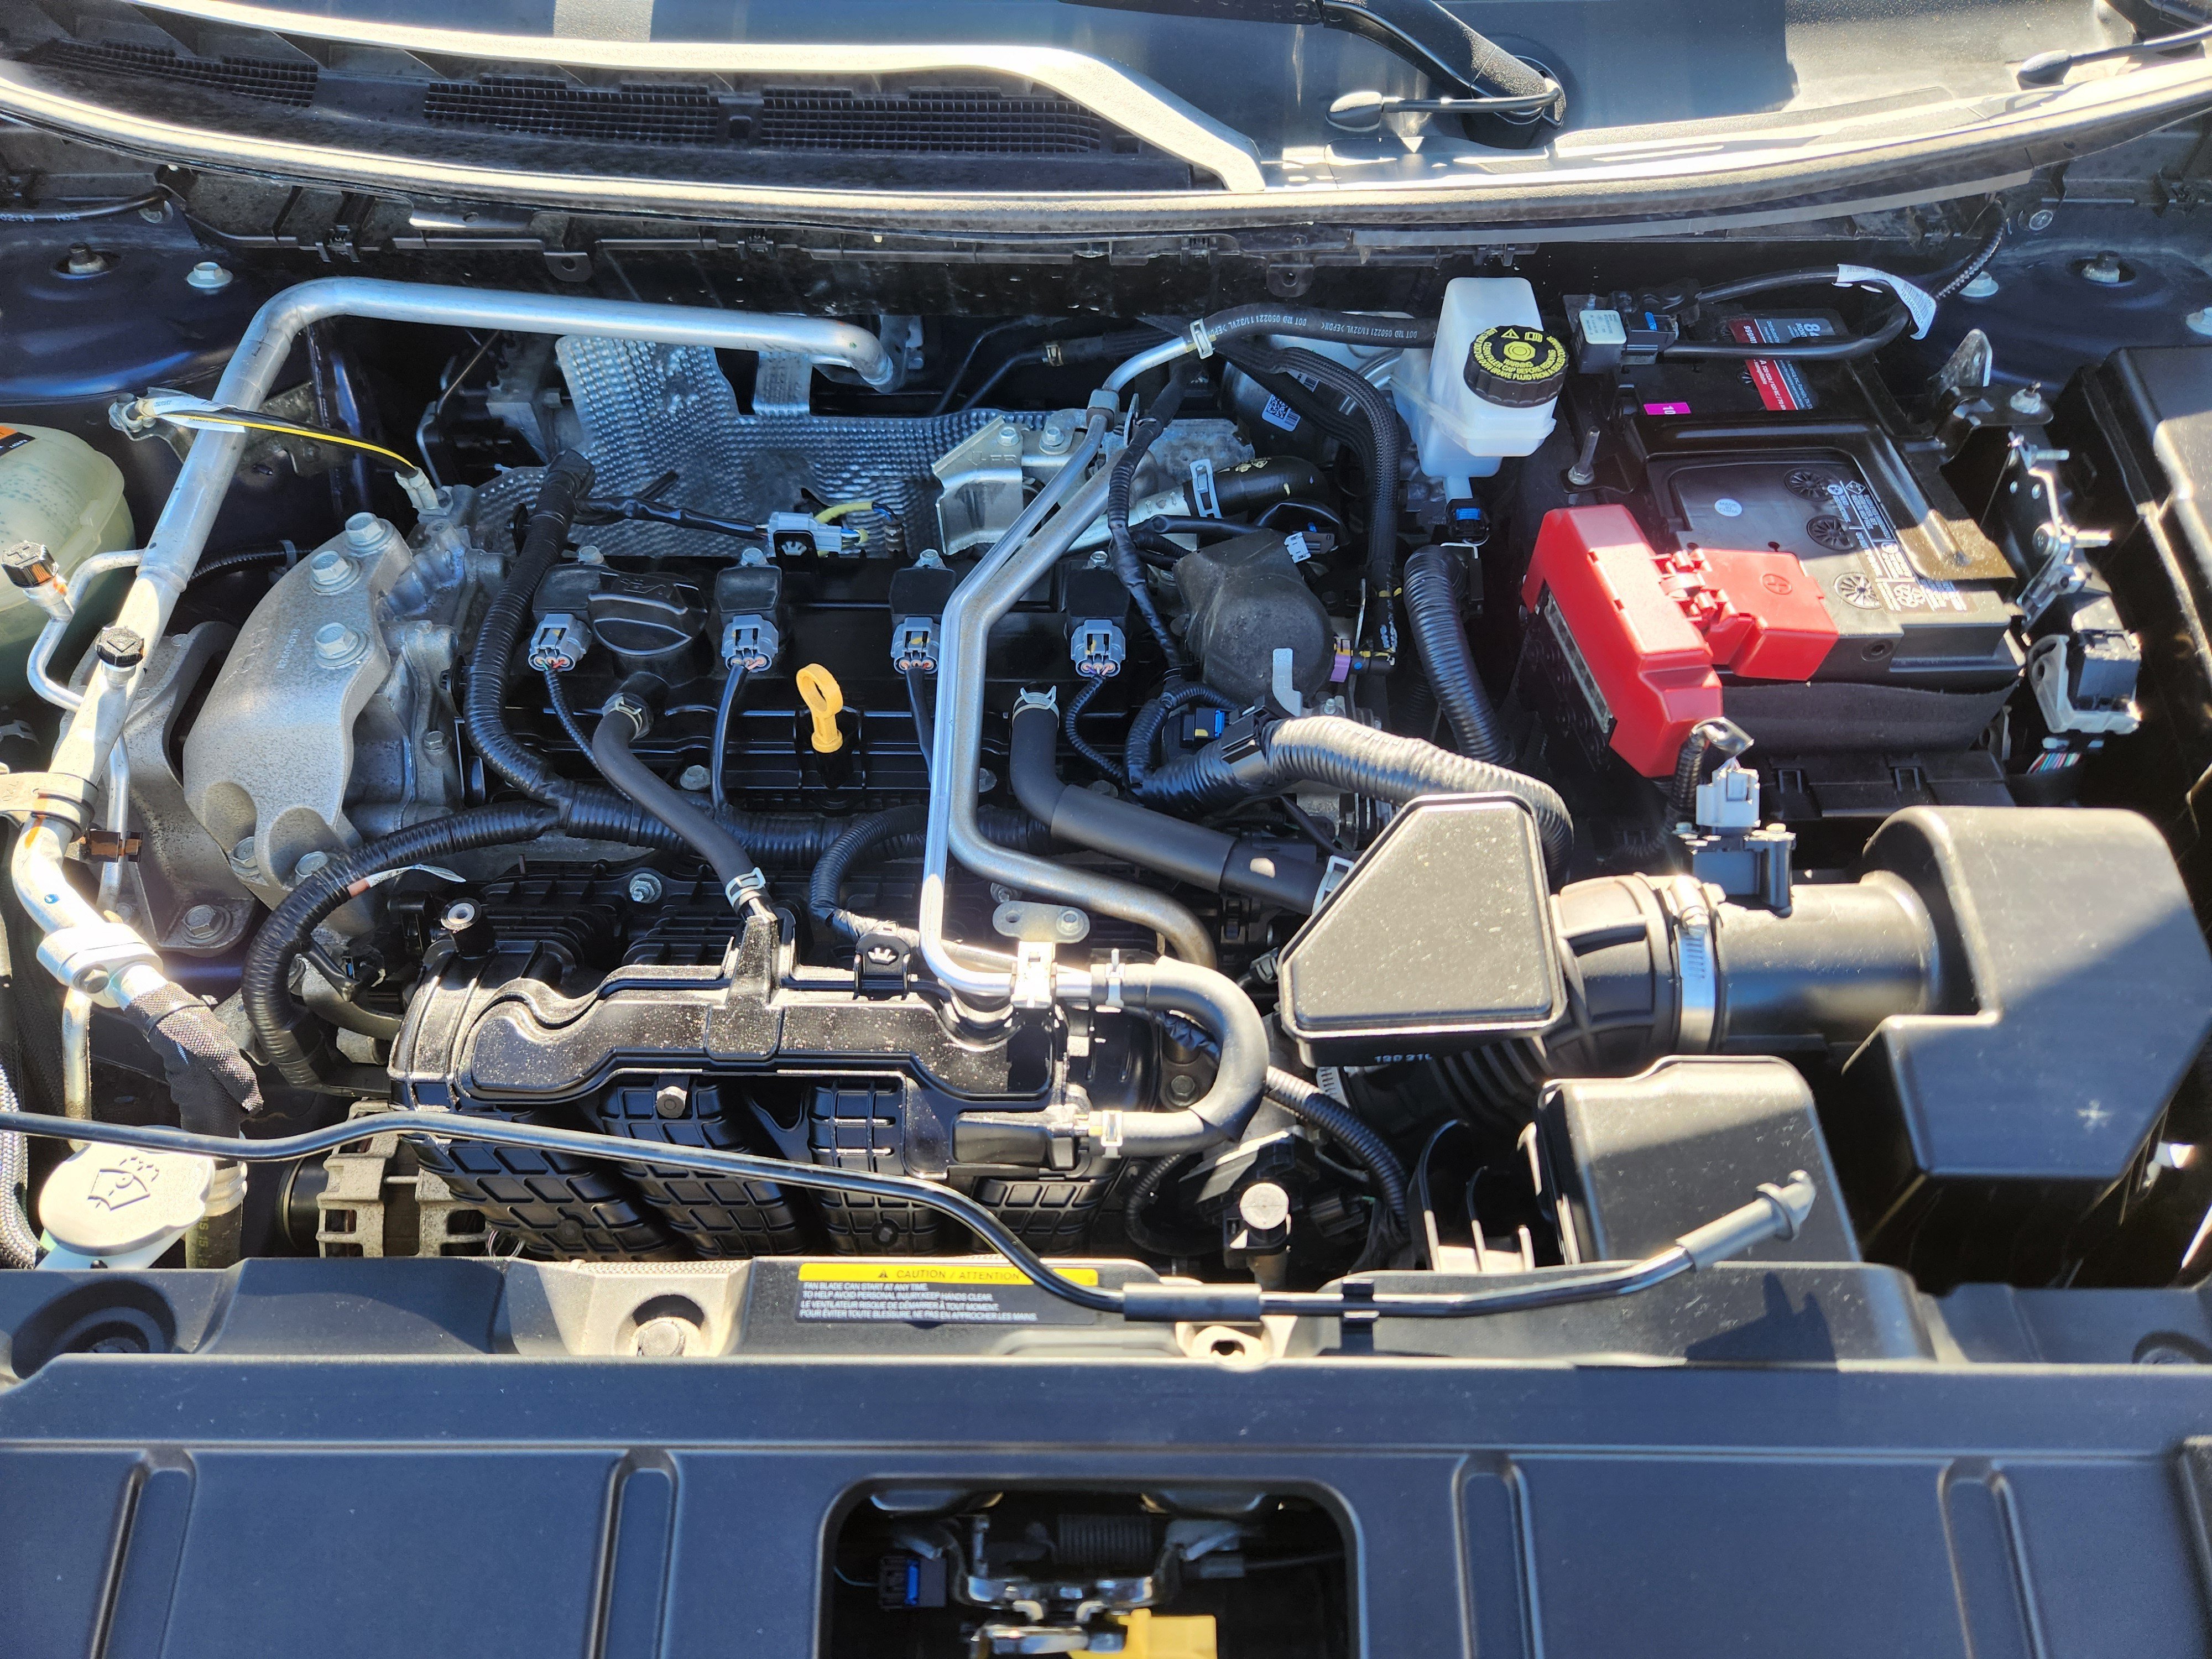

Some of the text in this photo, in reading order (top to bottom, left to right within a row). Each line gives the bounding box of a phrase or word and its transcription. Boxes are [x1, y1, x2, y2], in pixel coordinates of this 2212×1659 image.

[1256, 314, 1280, 323] 050221
[1295, 318, 1306, 326] DOT
[1371, 328, 1392, 337] 050221
[1406, 330, 1417, 338] DOT
[1485, 354, 1503, 368] FILLER
[1516, 366, 1543, 374] BEFORE
[1504, 358, 1533, 368] WARNING
[1490, 367, 1513, 379] BRAKE
[1662, 405, 1676, 415] 10
[990, 455, 1018, 465] FR
[896, 1270, 946, 1279] CAUTION
[959, 1271, 1019, 1280] ATTENTION
[815, 1291, 833, 1299] HELP
[857, 1291, 895, 1300] PERSONAL
[921, 1292, 941, 1300] KEEP
[941, 1292, 967, 1301] HANDS
[811, 1301, 858, 1309] VENTILATEUR
[858, 1301, 886, 1310] RISQUE
[886, 1301, 898, 1310] DE
[898, 1300, 939, 1311] DÉMARRER
[946, 1303, 966, 1311] TOUT
[799, 1309, 821, 1318] POUR
[848, 1310, 872, 1318] TOUTE
[912, 1310, 924, 1318] NE
[924, 1311, 940, 1319] PAS
[940, 1311, 951, 1319] EN
[951, 1312, 997, 1321] APPROCHER
